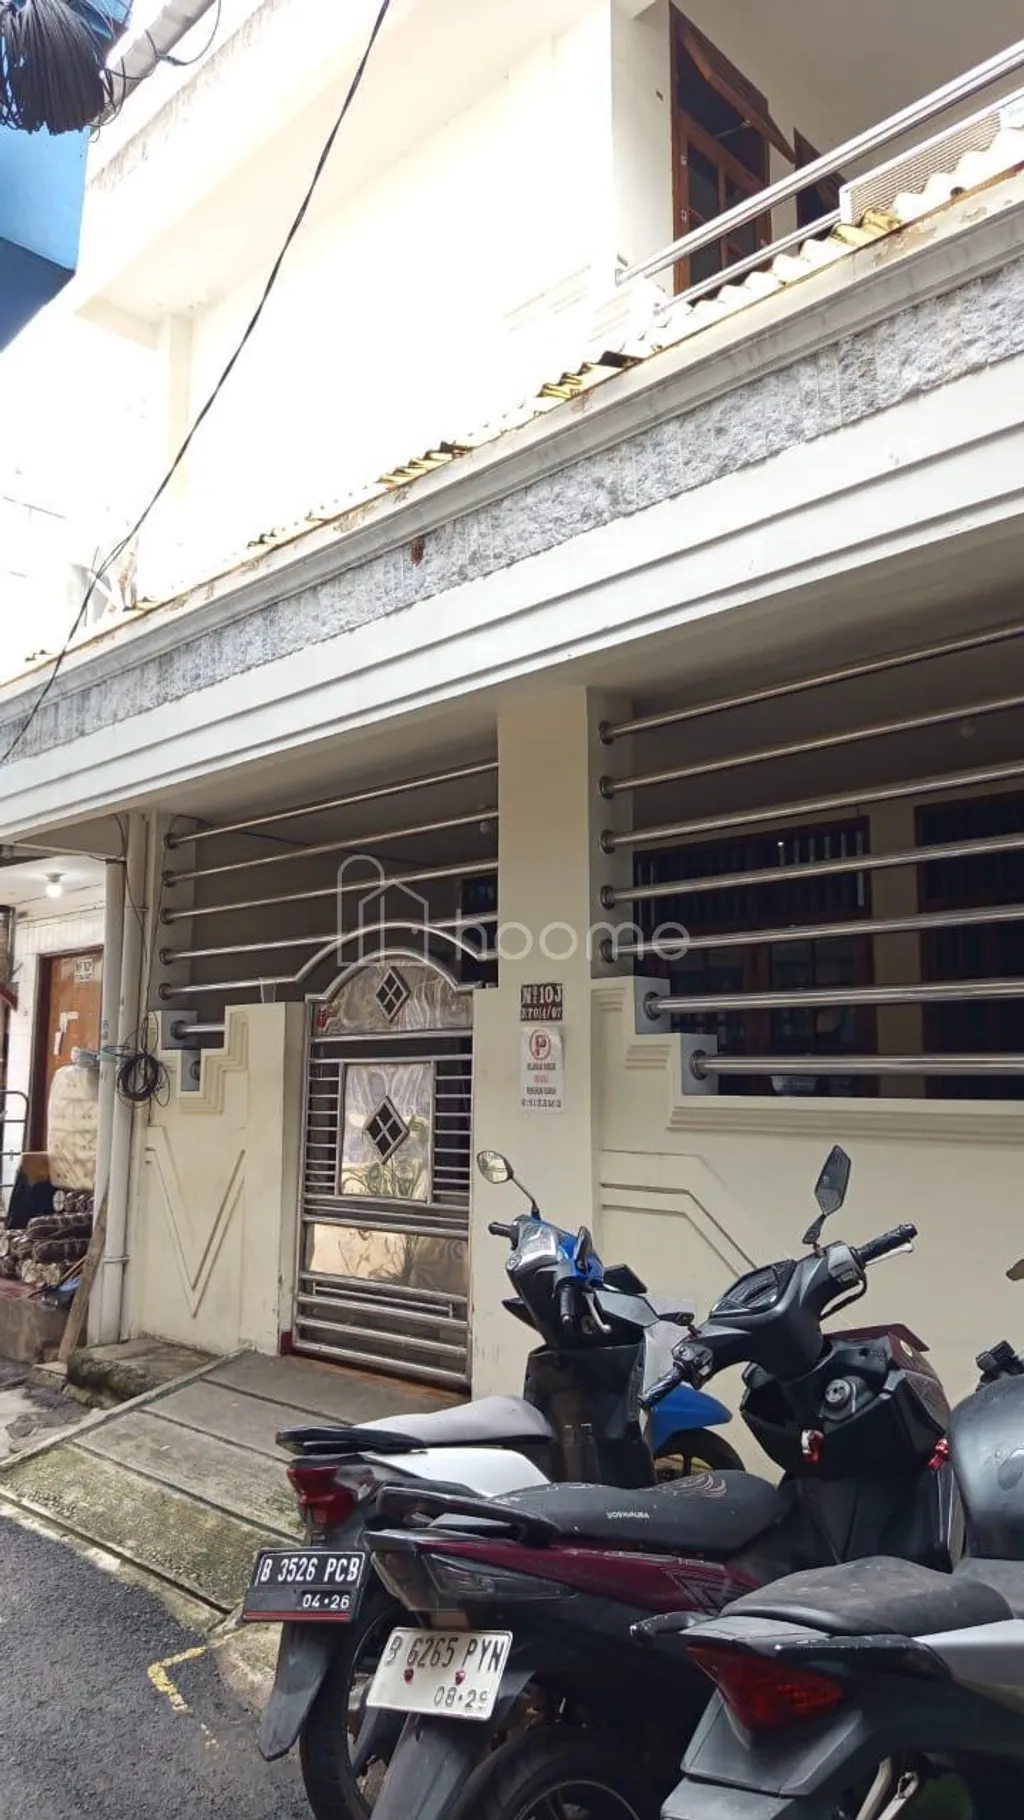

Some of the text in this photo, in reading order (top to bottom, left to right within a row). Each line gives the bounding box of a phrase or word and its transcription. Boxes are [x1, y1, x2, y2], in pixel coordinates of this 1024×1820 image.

[260, 1557, 360, 1582] B 3526 PCB
[406, 1636, 458, 1668] 6265
[462, 1638, 505, 1672] PYN
